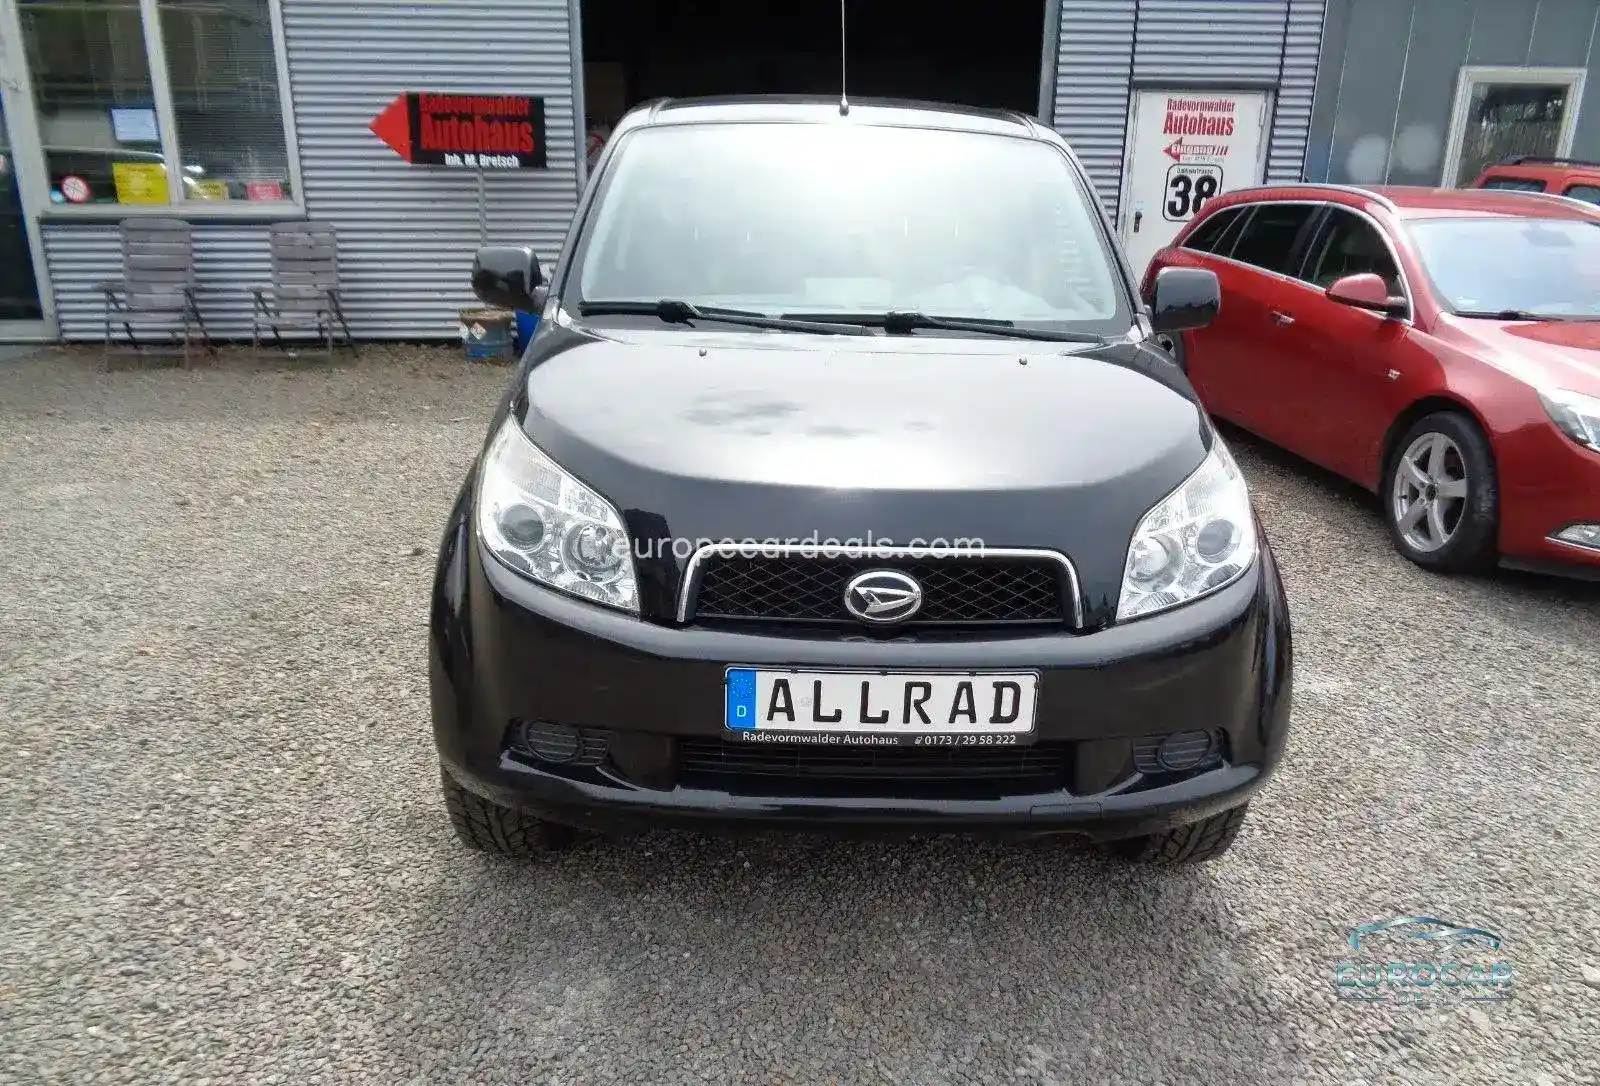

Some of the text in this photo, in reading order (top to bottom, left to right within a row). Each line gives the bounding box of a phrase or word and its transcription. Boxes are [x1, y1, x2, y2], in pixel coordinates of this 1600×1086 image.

[1166, 98, 1235, 112] Radevormwalder
[420, 113, 534, 155] Autohaus
[1163, 111, 1234, 136] Autohaus
[1167, 174, 1217, 217] 38
[736, 678, 1021, 724] D ALLRAD
[742, 731, 841, 744] Radevormwalder
[843, 734, 899, 745] Autohaus
[924, 735, 952, 746] 0173
[962, 735, 977, 745] 29
[979, 735, 993, 745] 58
[995, 734, 1017, 745] 222
